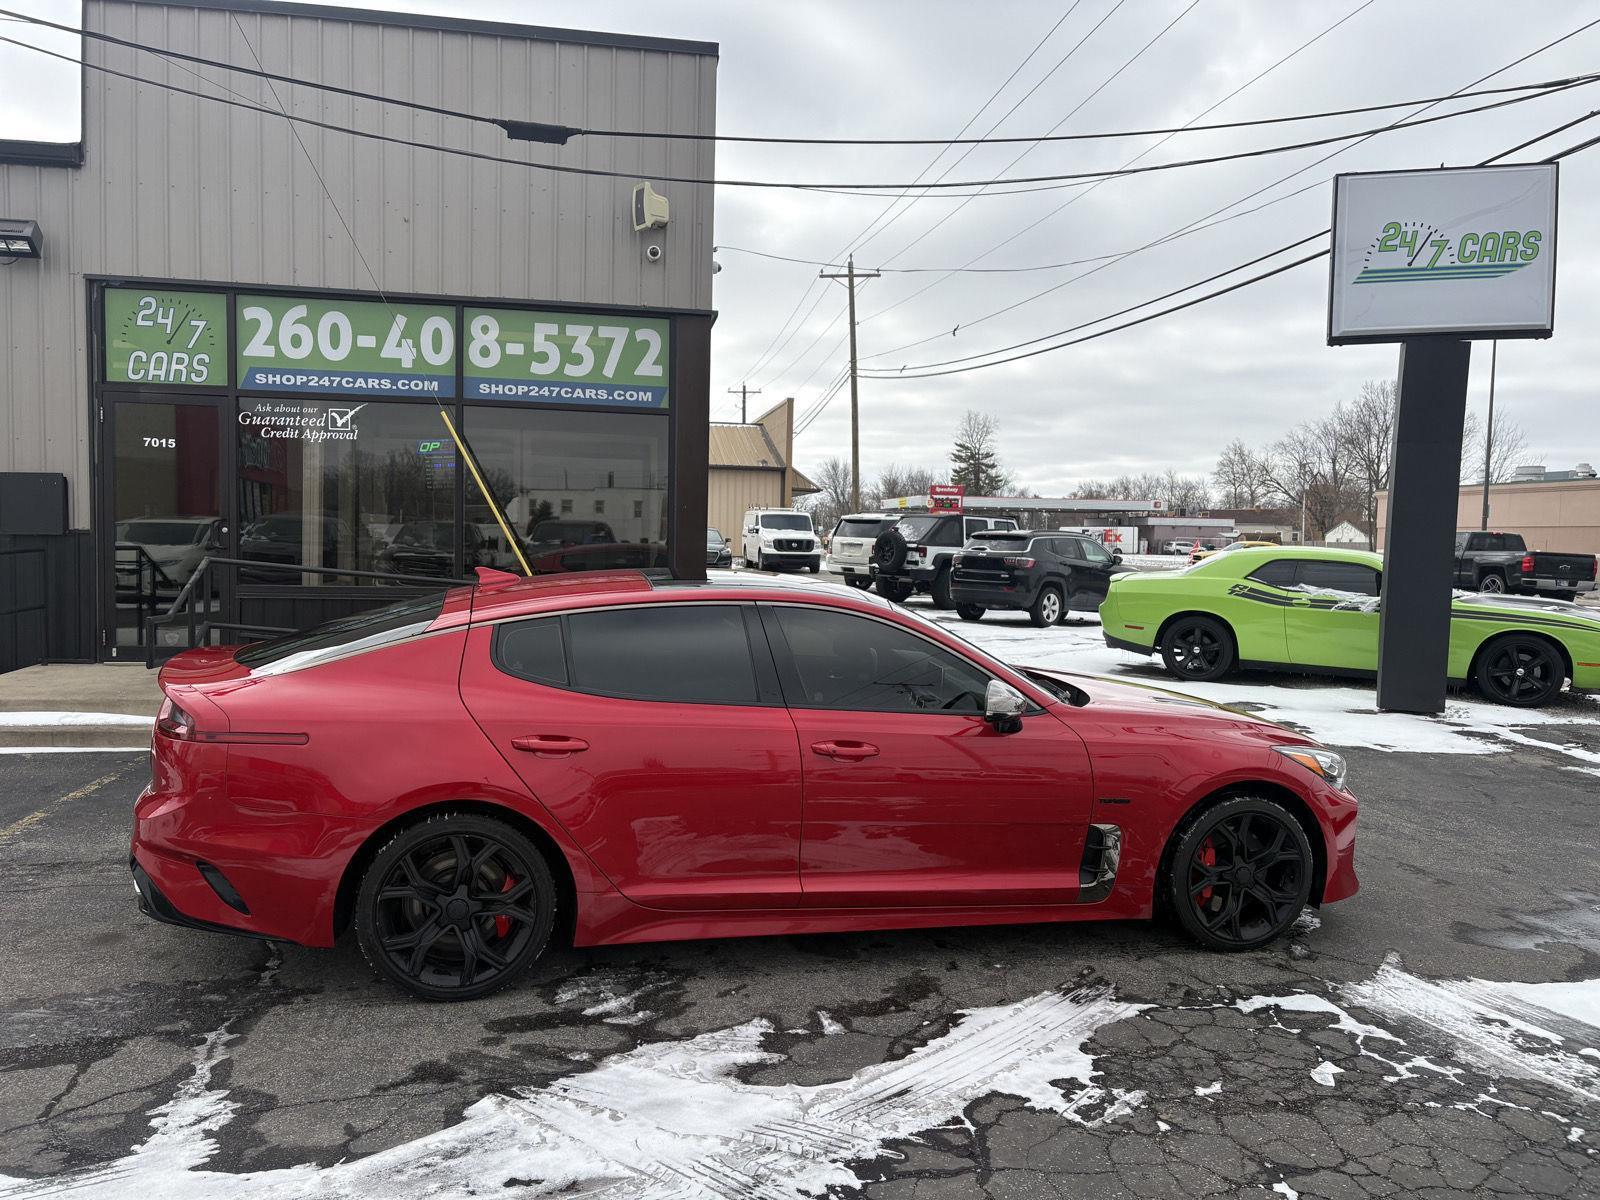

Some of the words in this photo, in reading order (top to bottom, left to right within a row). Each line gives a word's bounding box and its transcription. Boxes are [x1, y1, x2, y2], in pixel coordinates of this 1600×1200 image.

[1378, 221, 1450, 270] 24/7
[1457, 230, 1543, 264] CARS
[135, 296, 207, 349] 24/7
[126, 350, 210, 383] CARS
[254, 373, 439, 392] SHOP247CARS.COM
[478, 383, 653, 402] SHOP247CARS.COM
[255, 403, 272, 412] Ask
[274, 404, 300, 413] about
[238, 411, 327, 427] Guaranteed
[142, 437, 176, 448] 7015
[261, 427, 300, 438] Credit
[301, 429, 359, 443] Approval
